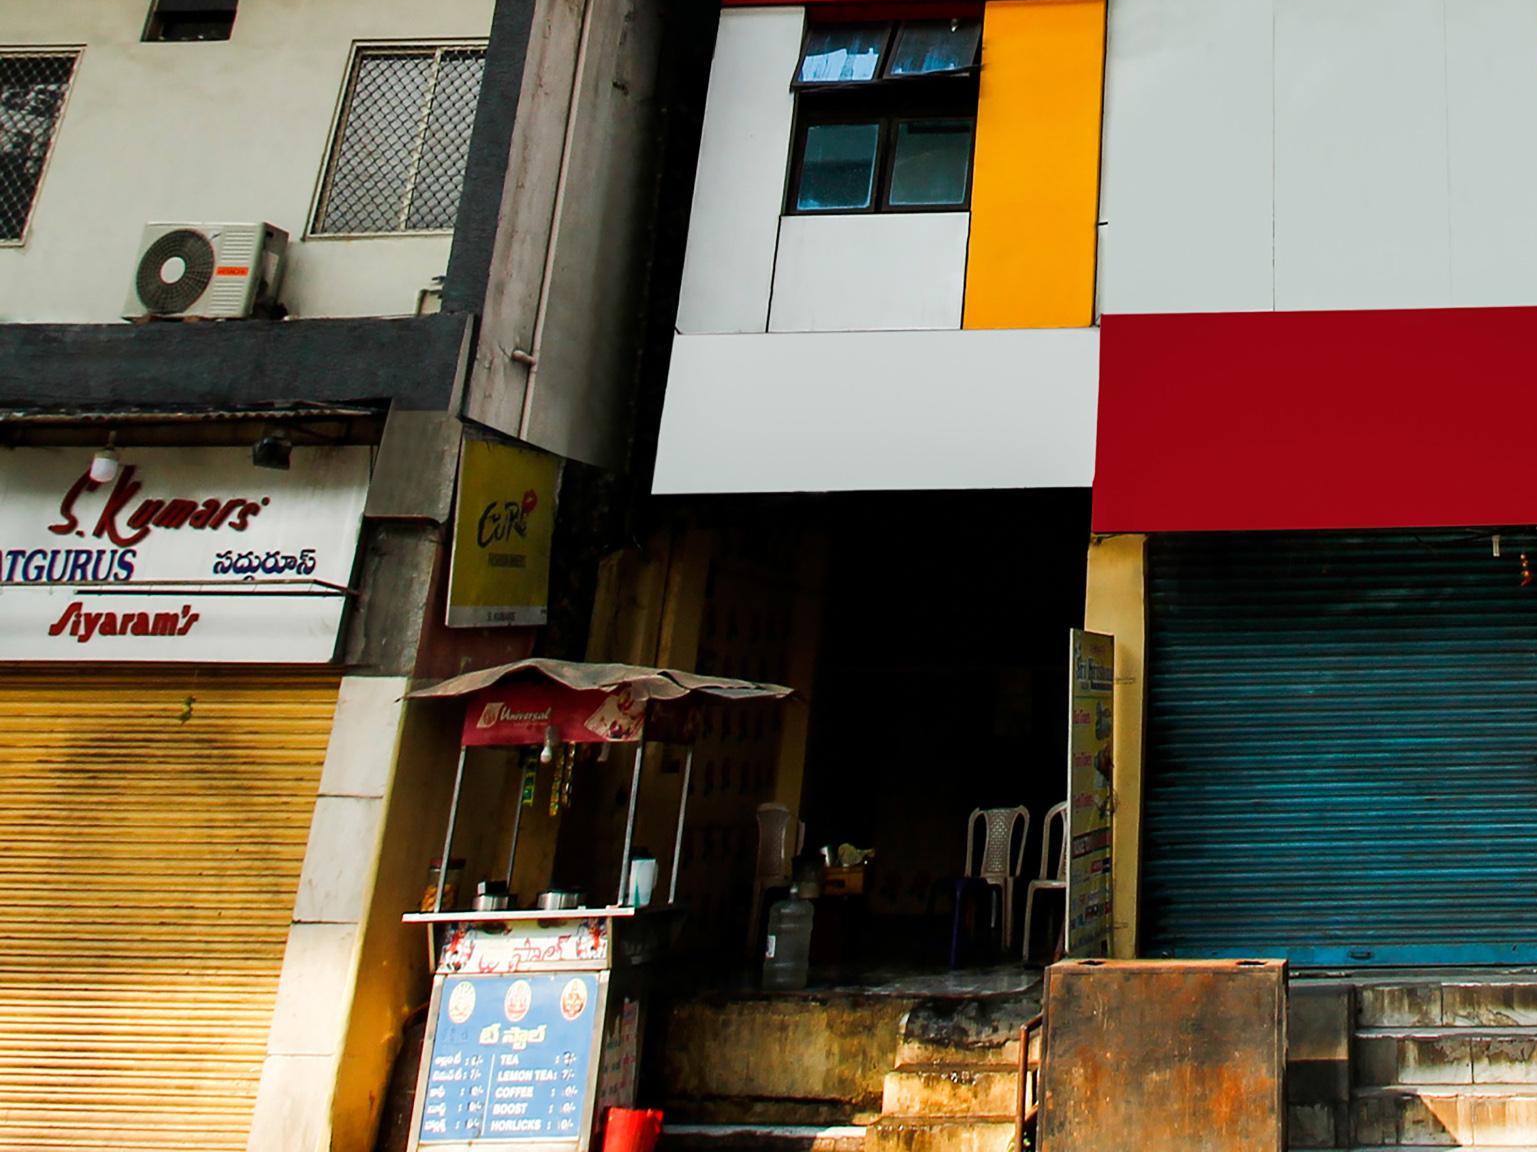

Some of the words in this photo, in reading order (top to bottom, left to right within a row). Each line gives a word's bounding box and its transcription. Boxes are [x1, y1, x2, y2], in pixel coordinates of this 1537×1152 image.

[0, 549, 137, 582] TGURUS
[48, 602, 200, 643] Siyaram's
[501, 1054, 519, 1065] TEA
[498, 1070, 532, 1081] LEMON
[496, 1086, 534, 1098] COFFEE
[493, 1103, 528, 1115] BOOST
[491, 1119, 541, 1132] HORLICKS
